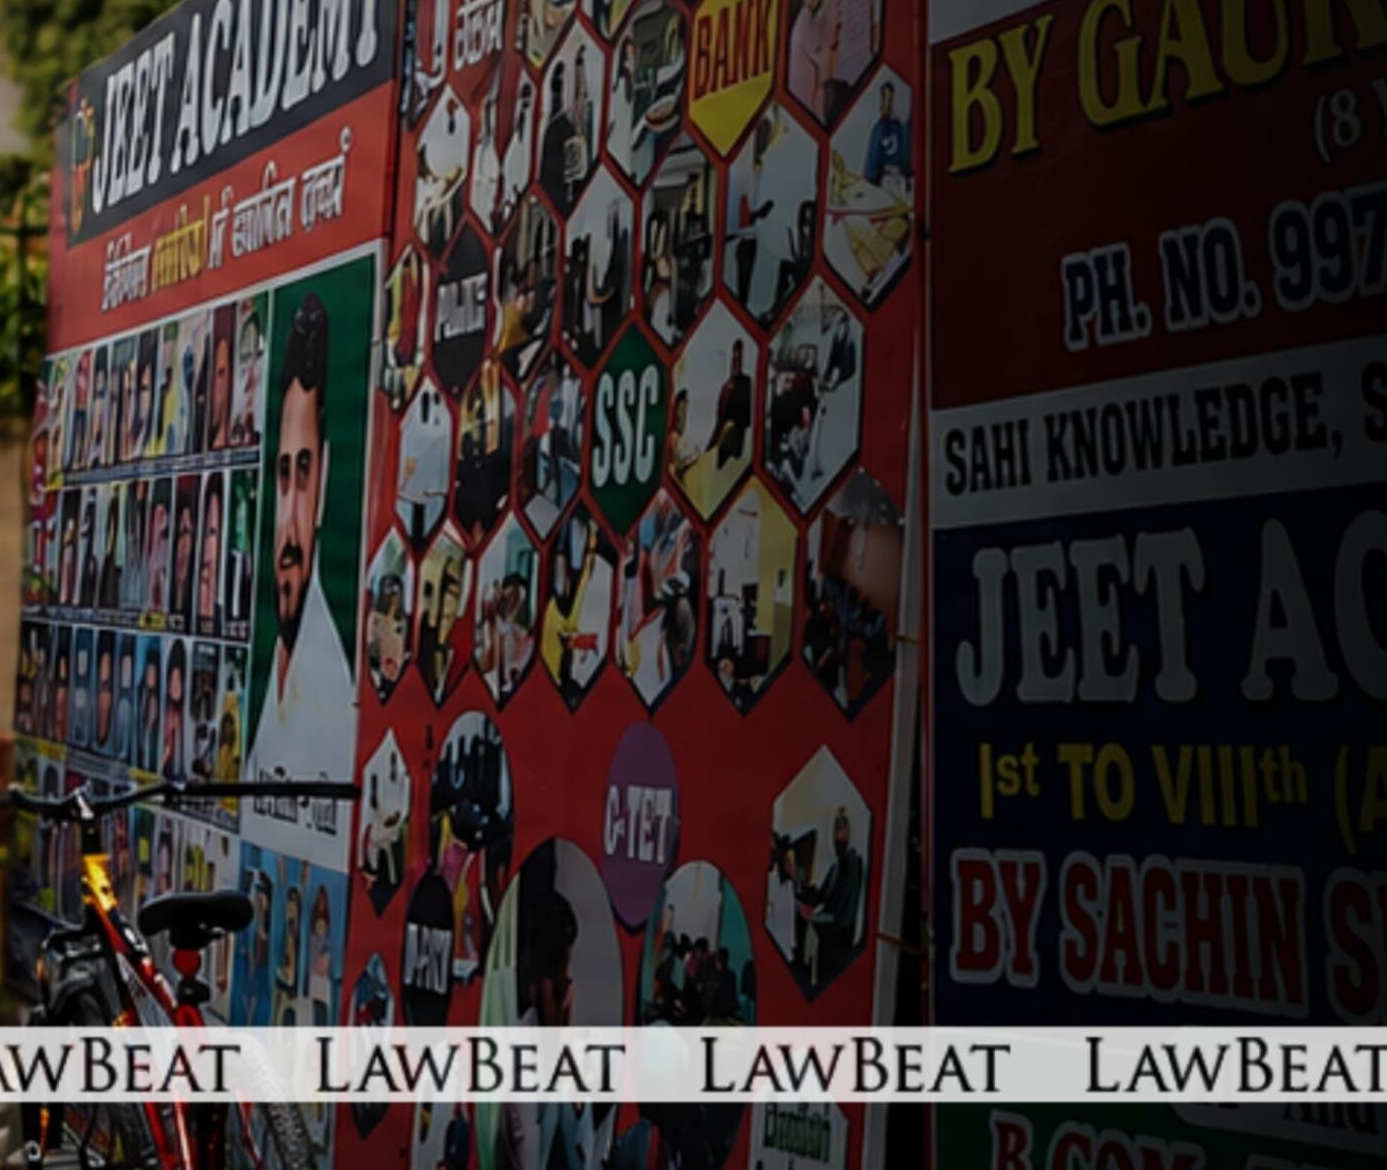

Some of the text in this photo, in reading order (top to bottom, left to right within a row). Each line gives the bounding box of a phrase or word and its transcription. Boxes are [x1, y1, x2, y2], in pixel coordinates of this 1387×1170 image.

[91, 31, 175, 214] JEET
[947, 13, 1056, 174] BY
[1060, 239, 1153, 353] PH.
[1157, 216, 1263, 333] NO.
[591, 362, 659, 488] SSC
[946, 415, 1032, 495] SAHI
[1046, 371, 1342, 481] KNOWLEDGE,
[954, 526, 1210, 708] JEET
[604, 783, 674, 864] C-TET
[1055, 741, 1138, 822] TO
[949, 846, 1048, 988] BY
[1059, 848, 1309, 1020] SACHIN
